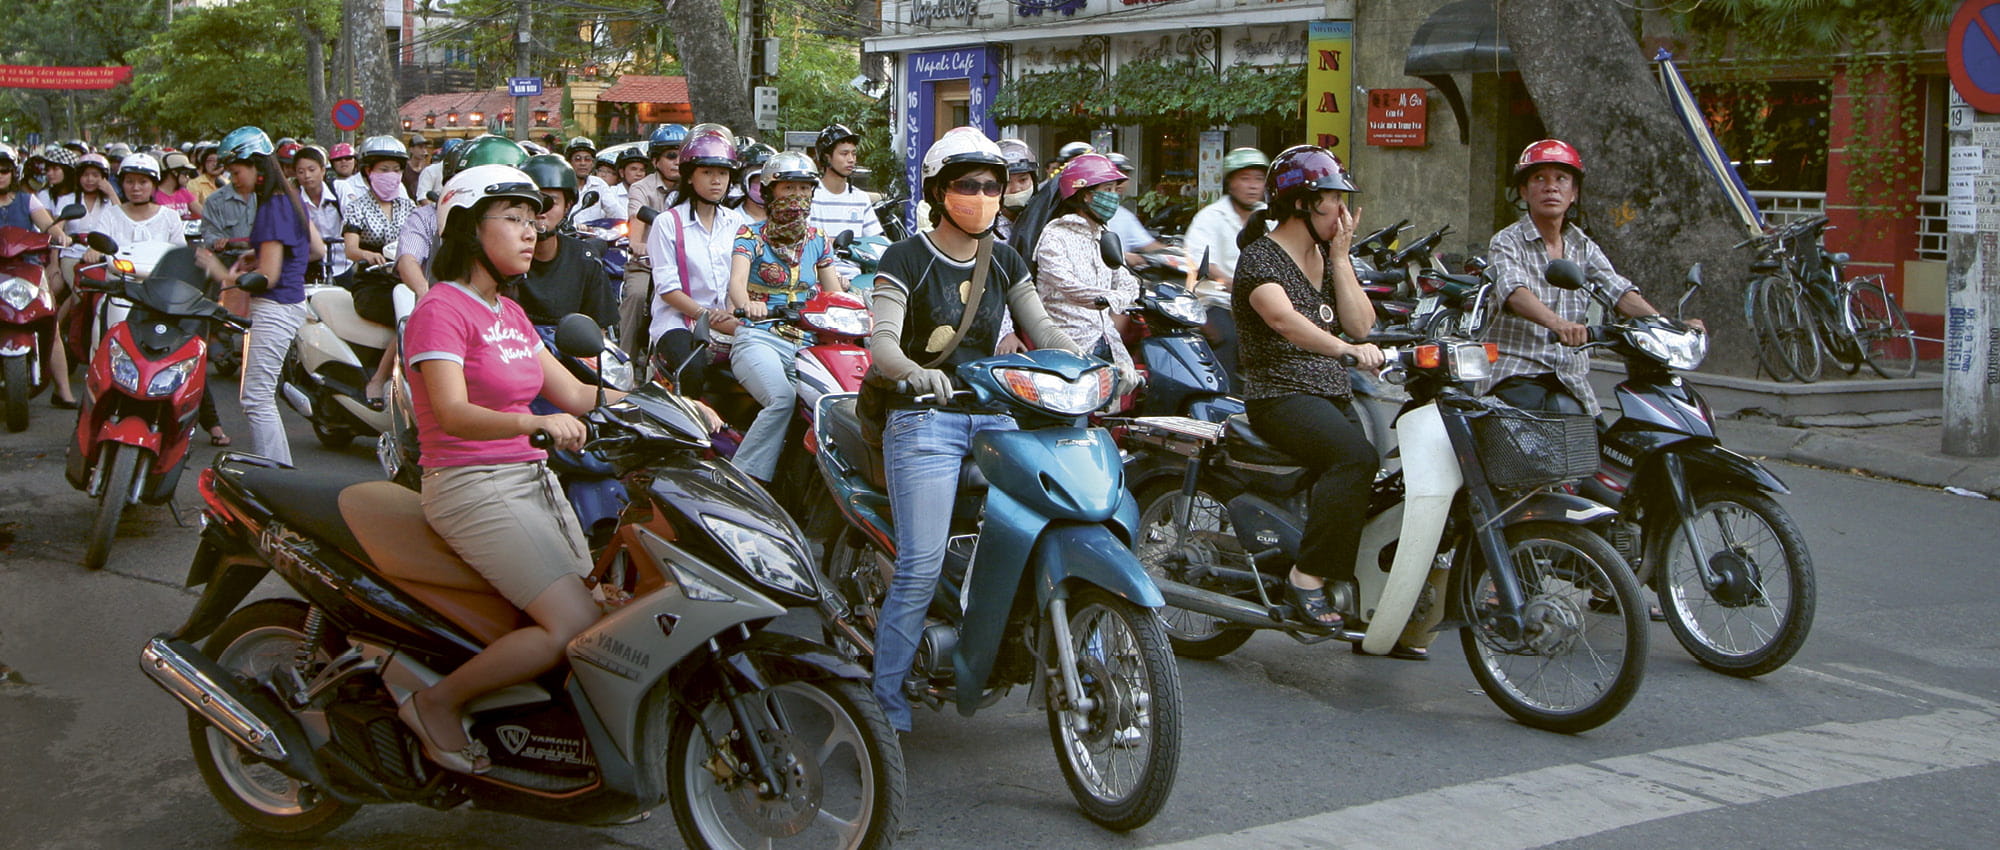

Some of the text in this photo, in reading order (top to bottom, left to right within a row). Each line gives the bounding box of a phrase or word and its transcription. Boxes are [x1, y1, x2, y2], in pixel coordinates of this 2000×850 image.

[915, 51, 976, 77] Napoli Café
[907, 91, 918, 108] 16
[971, 88, 982, 105] 16
[1951, 109, 1962, 126] 19
[1602, 444, 1633, 467] YAMAHA
[597, 632, 650, 670] YAMAHA
[530, 734, 580, 747] YAMAHA
